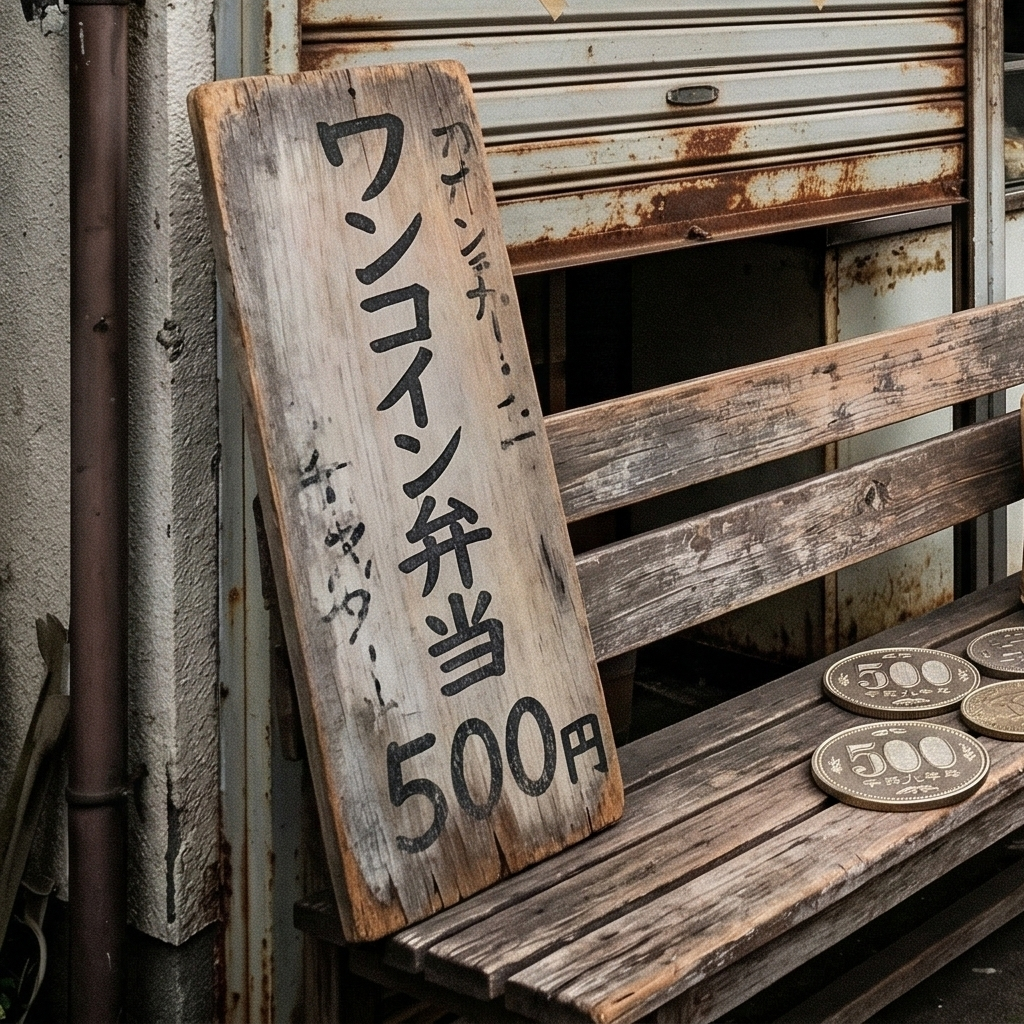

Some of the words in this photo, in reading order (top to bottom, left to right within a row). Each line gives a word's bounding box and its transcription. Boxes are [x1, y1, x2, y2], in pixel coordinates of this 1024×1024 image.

[316, 112, 506, 697] ワンコイン弁当
[857, 659, 953, 690] 500
[386, 696, 609, 855] 500円
[846, 736, 957, 778] 500
